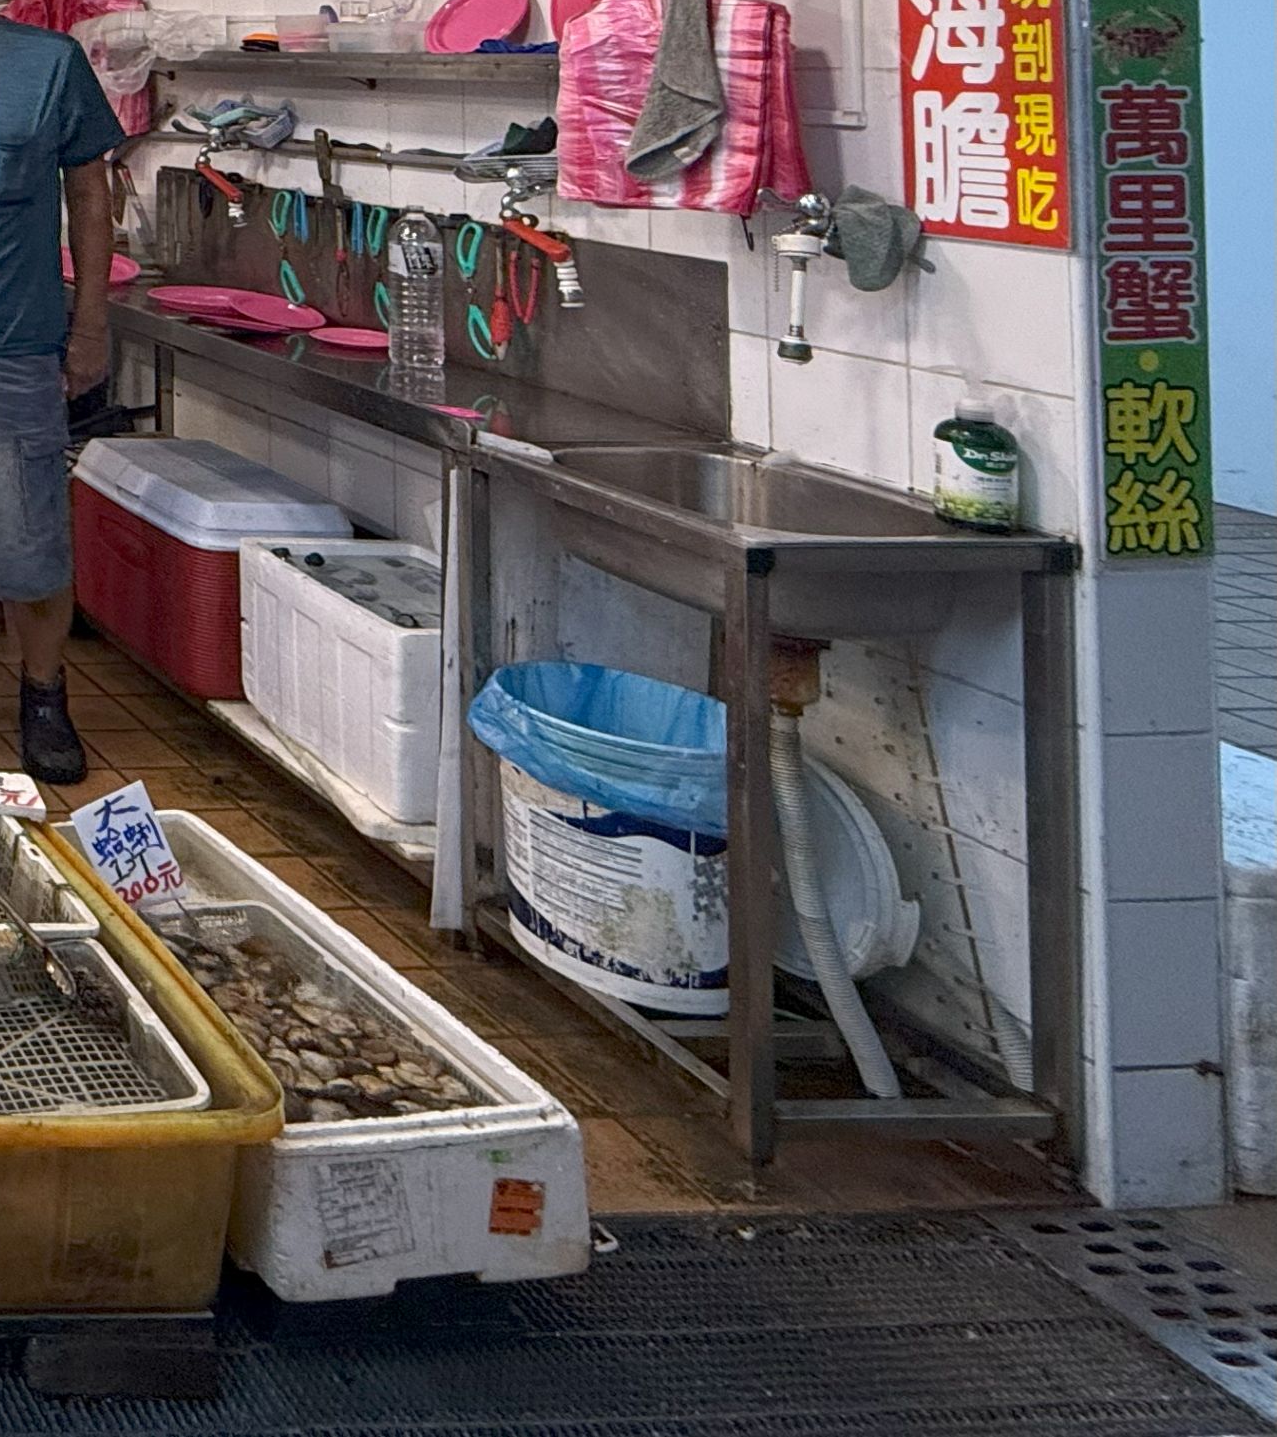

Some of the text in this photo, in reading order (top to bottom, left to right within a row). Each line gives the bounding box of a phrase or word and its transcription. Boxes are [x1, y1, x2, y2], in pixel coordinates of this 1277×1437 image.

[1100, 80, 1199, 345] 萬里蟹
[1104, 379, 1202, 556] 軟絲
[94, 795, 140, 832] 大
